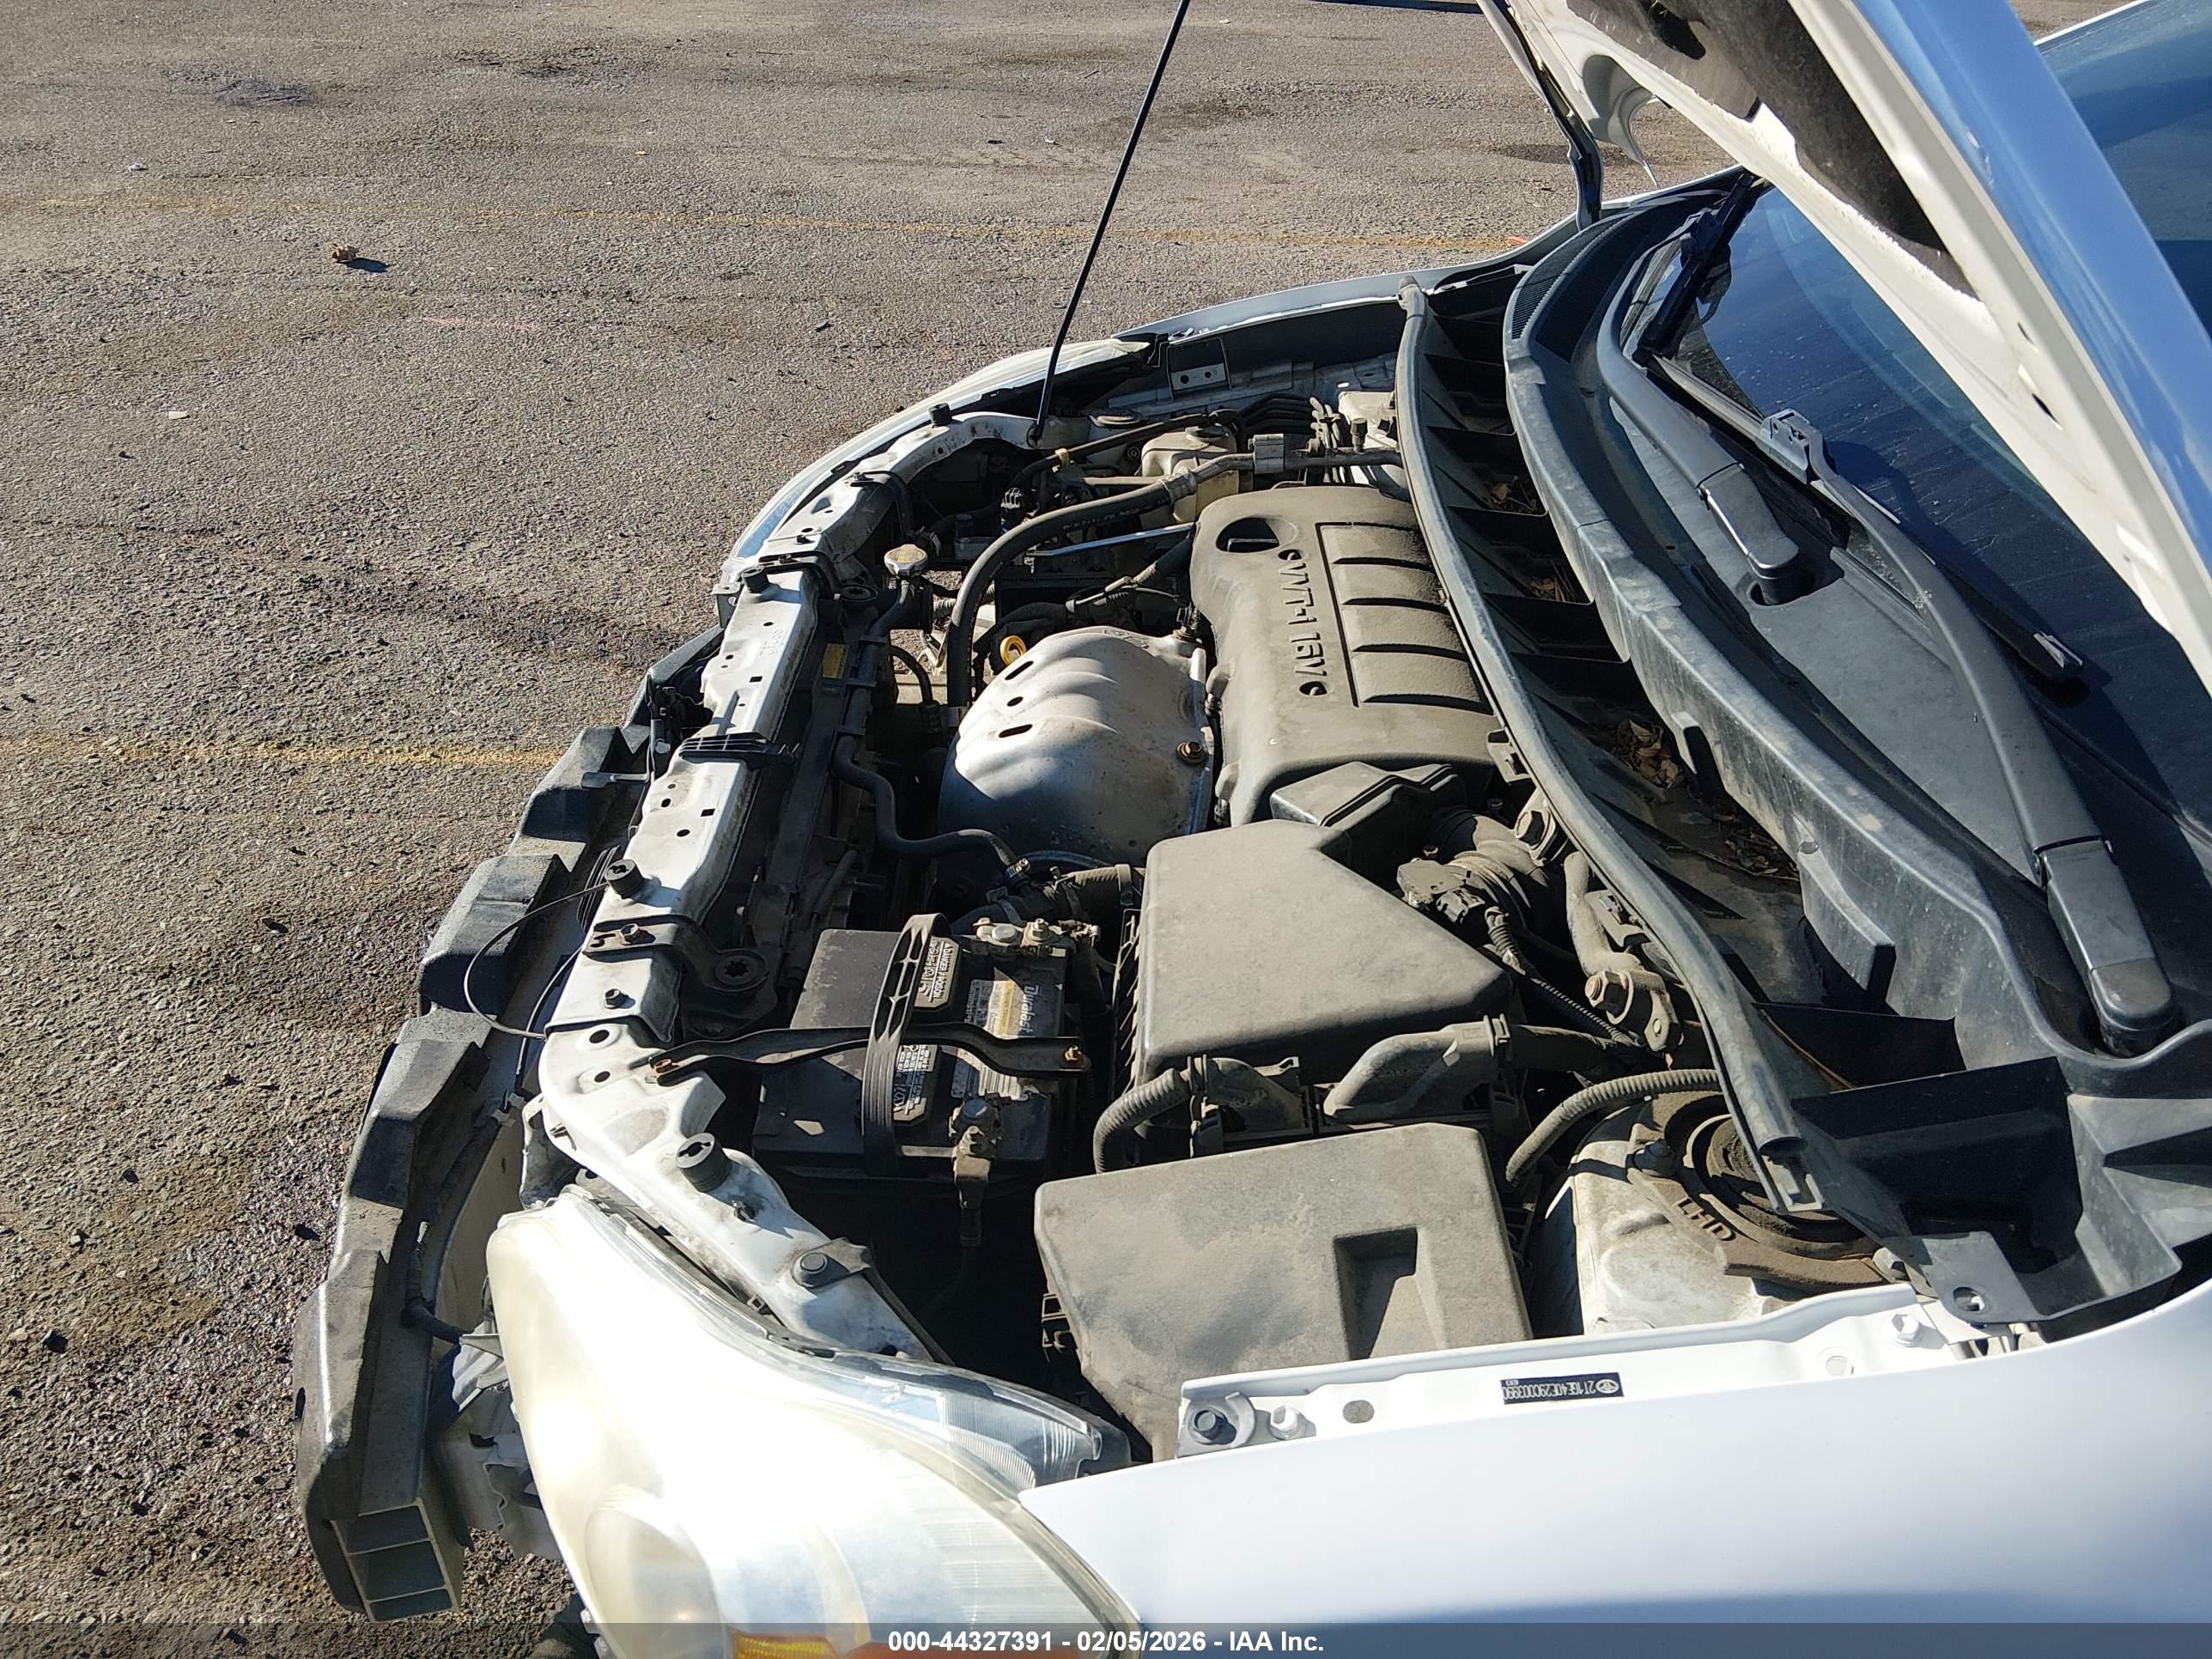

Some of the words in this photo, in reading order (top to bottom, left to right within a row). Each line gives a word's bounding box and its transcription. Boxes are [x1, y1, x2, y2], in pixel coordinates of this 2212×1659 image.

[1291, 631, 1328, 677] 16V
[939, 947, 953, 972] DANGER
[933, 975, 946, 999] POISON
[1019, 984, 1039, 1033] Duralast
[1674, 1198, 1735, 1241] LHD
